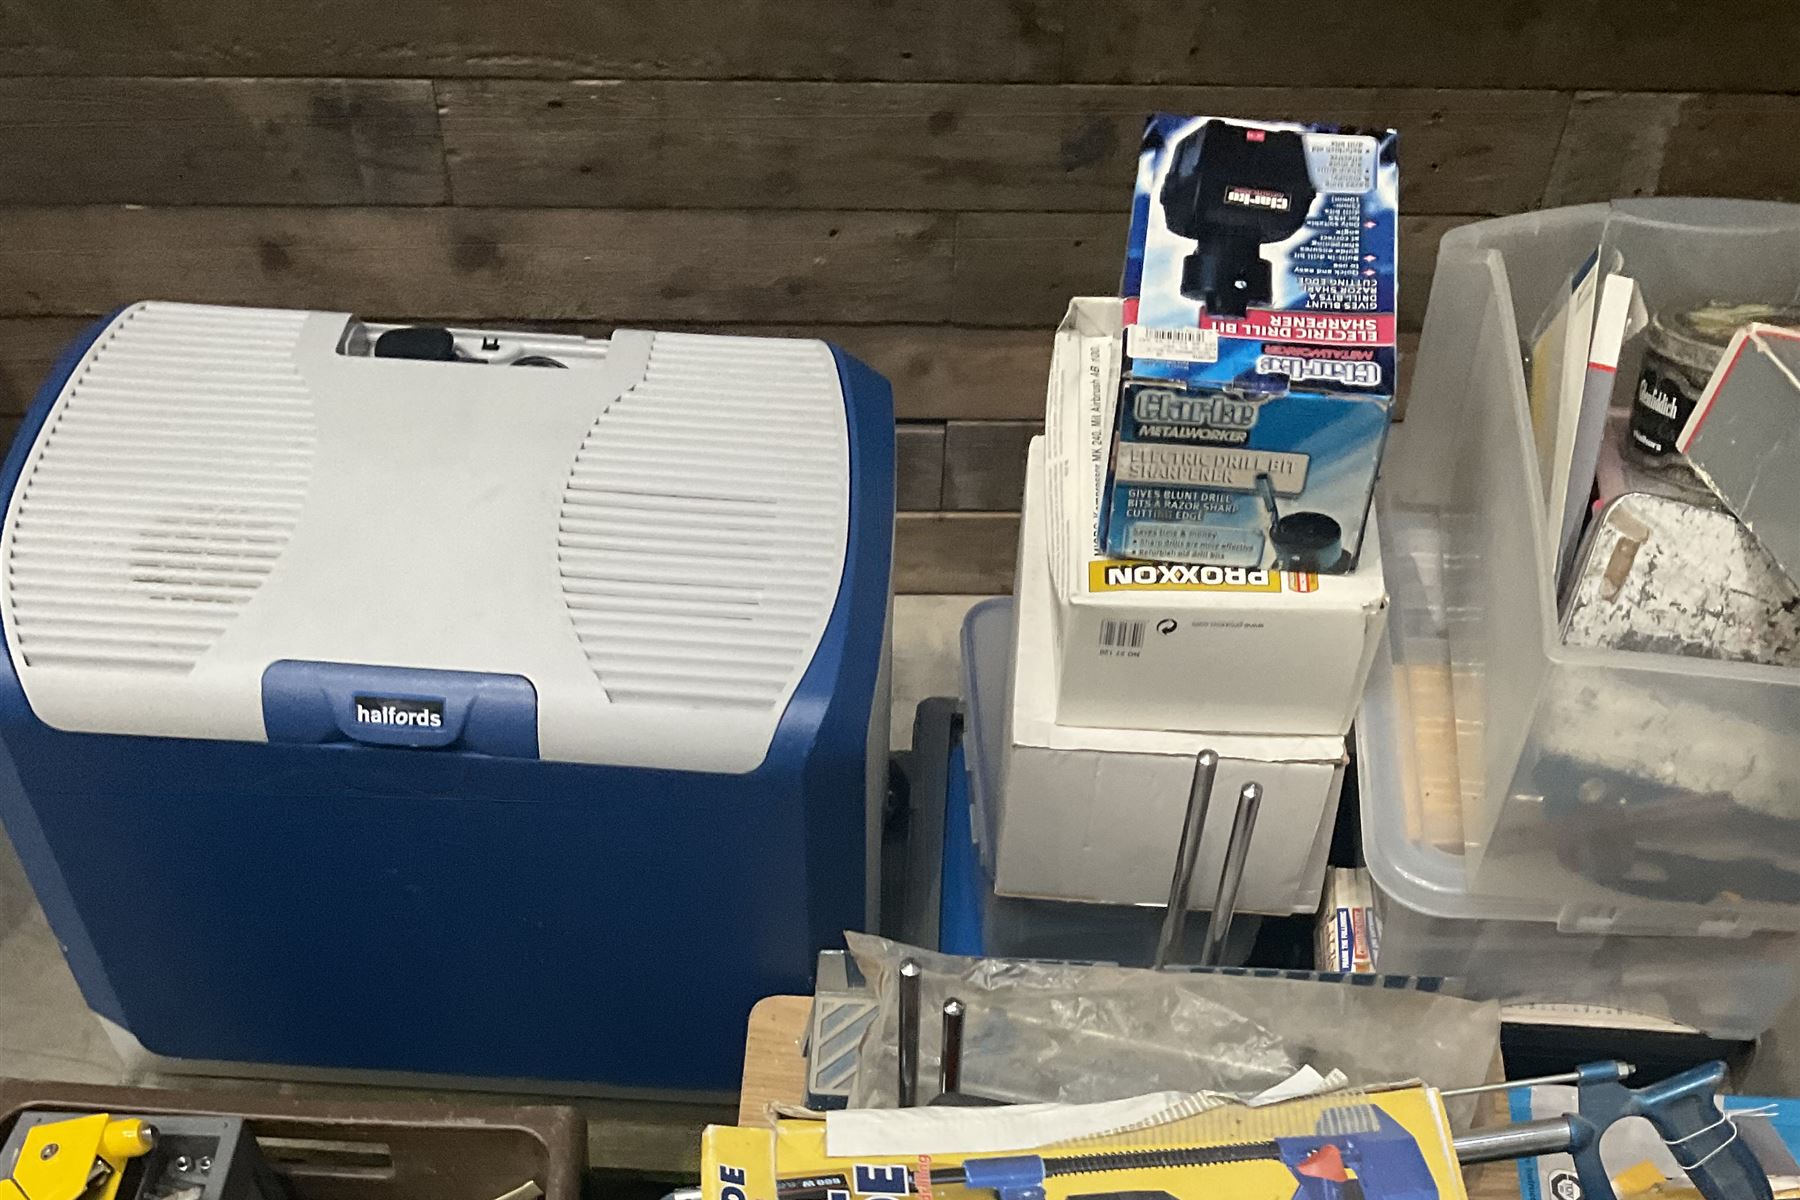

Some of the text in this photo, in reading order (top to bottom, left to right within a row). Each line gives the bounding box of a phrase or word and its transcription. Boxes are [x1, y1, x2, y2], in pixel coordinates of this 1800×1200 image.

[1316, 267, 1333, 275] and
[1334, 268, 1360, 277] Quick
[1329, 277, 1378, 287] CUTTING
[1340, 285, 1378, 295] RAZOR
[1309, 292, 1378, 303] DRILL BITS A
[1304, 299, 1378, 310] GIVES BLUNT
[1269, 315, 1377, 331] SHARPENER
[1210, 321, 1378, 342] ELECTRIC DRILL BIT
[1255, 355, 1381, 387] Clarke
[1133, 388, 1260, 430] Clarke
[1138, 425, 1248, 443] METALWORKER
[1267, 457, 1298, 475] BIT
[1128, 488, 1161, 499] GIVES
[1163, 489, 1198, 500] BLUNT
[1127, 499, 1152, 509] BITS
[1164, 501, 1200, 511] RAZOR
[1175, 510, 1203, 520] EDGE
[1107, 564, 1270, 586] PROXXON
[356, 703, 442, 727] halfords
